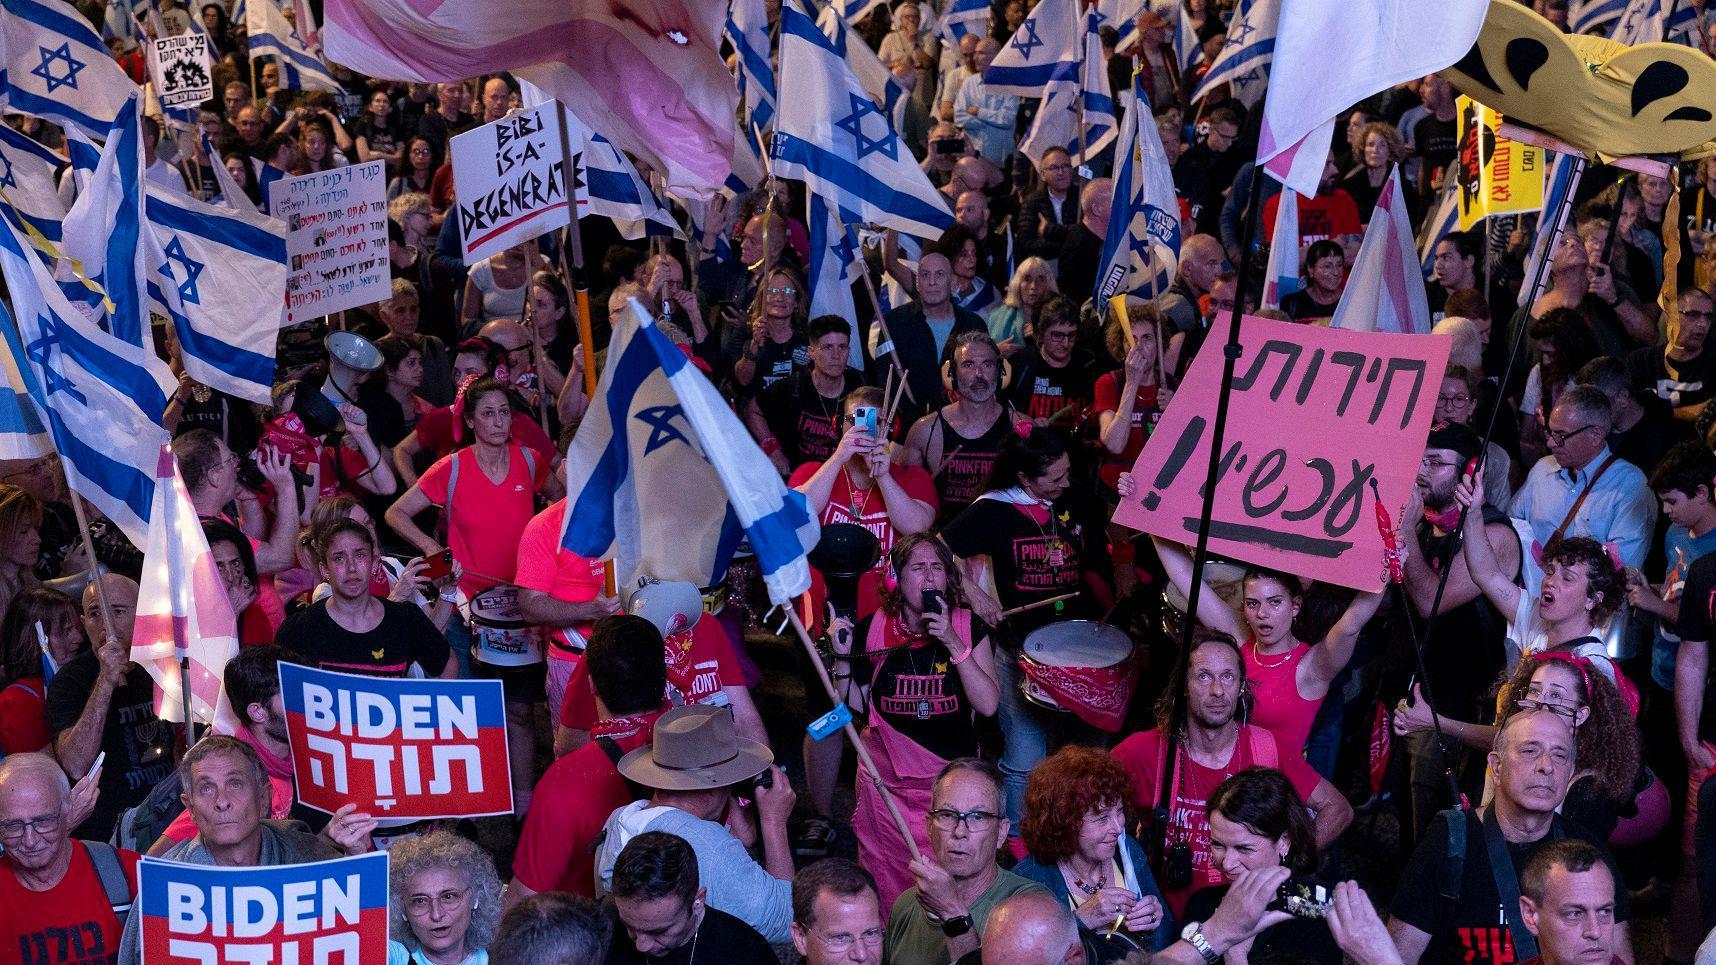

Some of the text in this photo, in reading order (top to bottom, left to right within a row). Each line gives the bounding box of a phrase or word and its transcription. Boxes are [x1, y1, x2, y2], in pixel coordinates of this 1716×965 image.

[157, 36, 204, 50] מי שהרס
[159, 47, 204, 63] לא יתקן
[496, 111, 544, 150] BiBi
[346, 167, 353, 182] 4
[460, 151, 586, 241] DEGENERATE
[371, 200, 385, 213] אחד
[370, 220, 385, 232] אחד
[371, 238, 386, 249] אחד
[1230, 340, 1427, 431] חירות
[302, 682, 479, 740] BIDEN
[167, 873, 361, 938] BIDEN
